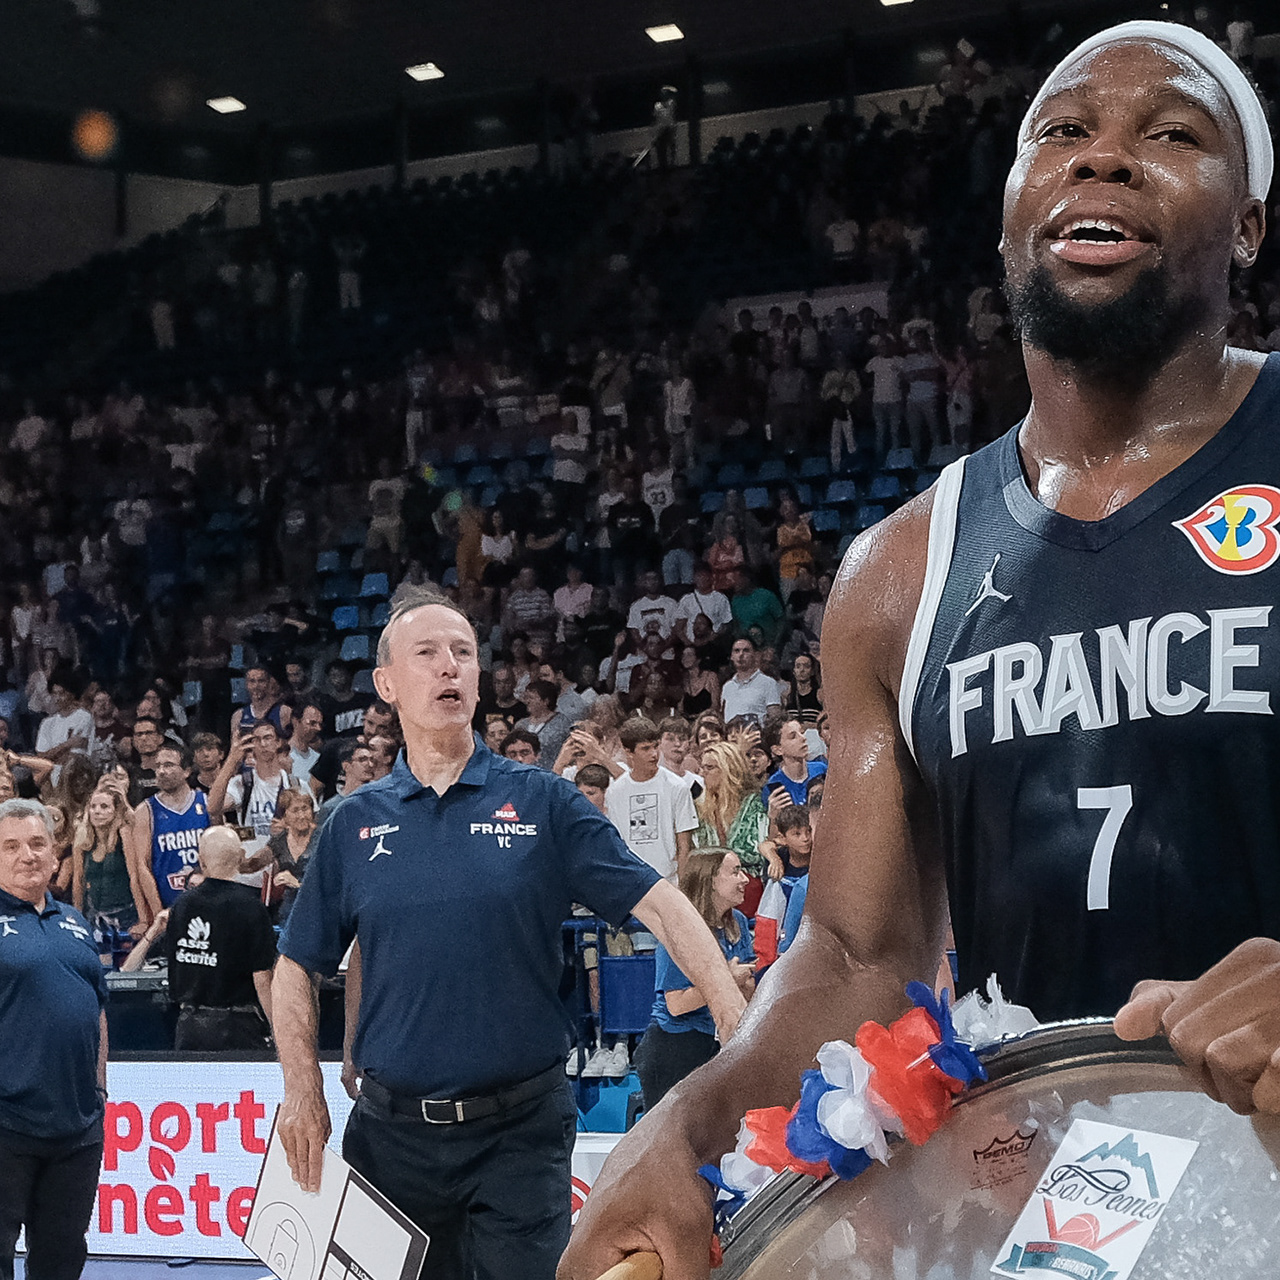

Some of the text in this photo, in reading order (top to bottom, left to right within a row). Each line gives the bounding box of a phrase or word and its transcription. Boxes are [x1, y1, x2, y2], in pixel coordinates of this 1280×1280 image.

[945, 605, 1275, 760] FRANCE
[470, 823, 538, 836] FRANCE
[497, 836, 512, 848] VC
[178, 848, 199, 865] 10
[1077, 784, 1134, 912] 7
[175, 950, 219, 968] écurité
[103, 1089, 267, 1171] port
[1036, 1164, 1086, 1202] Los
